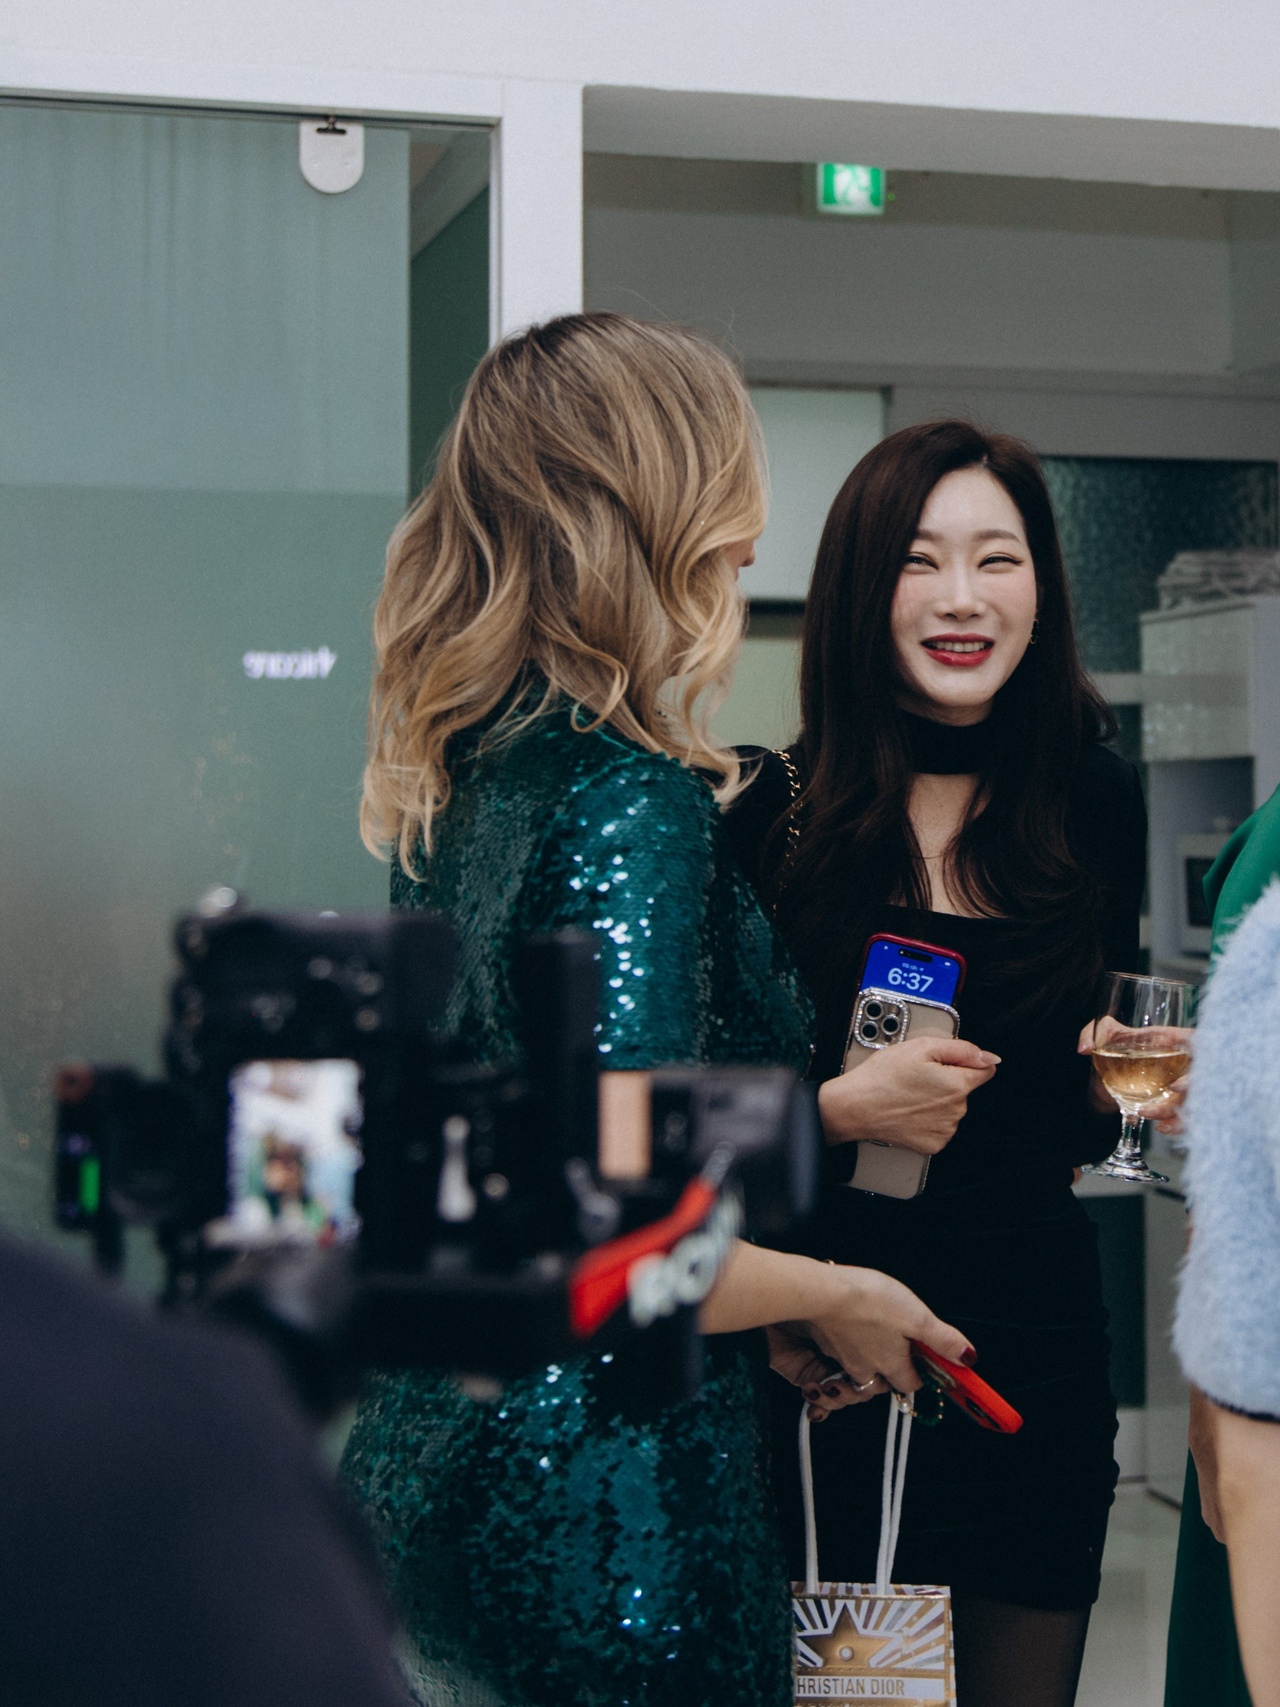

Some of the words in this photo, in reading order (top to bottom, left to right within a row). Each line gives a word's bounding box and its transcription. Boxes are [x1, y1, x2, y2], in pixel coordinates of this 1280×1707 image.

[888, 967, 934, 993] 6:37
[797, 1677, 866, 1695] HRISTIAN
[870, 1678, 905, 1696] DIOR
